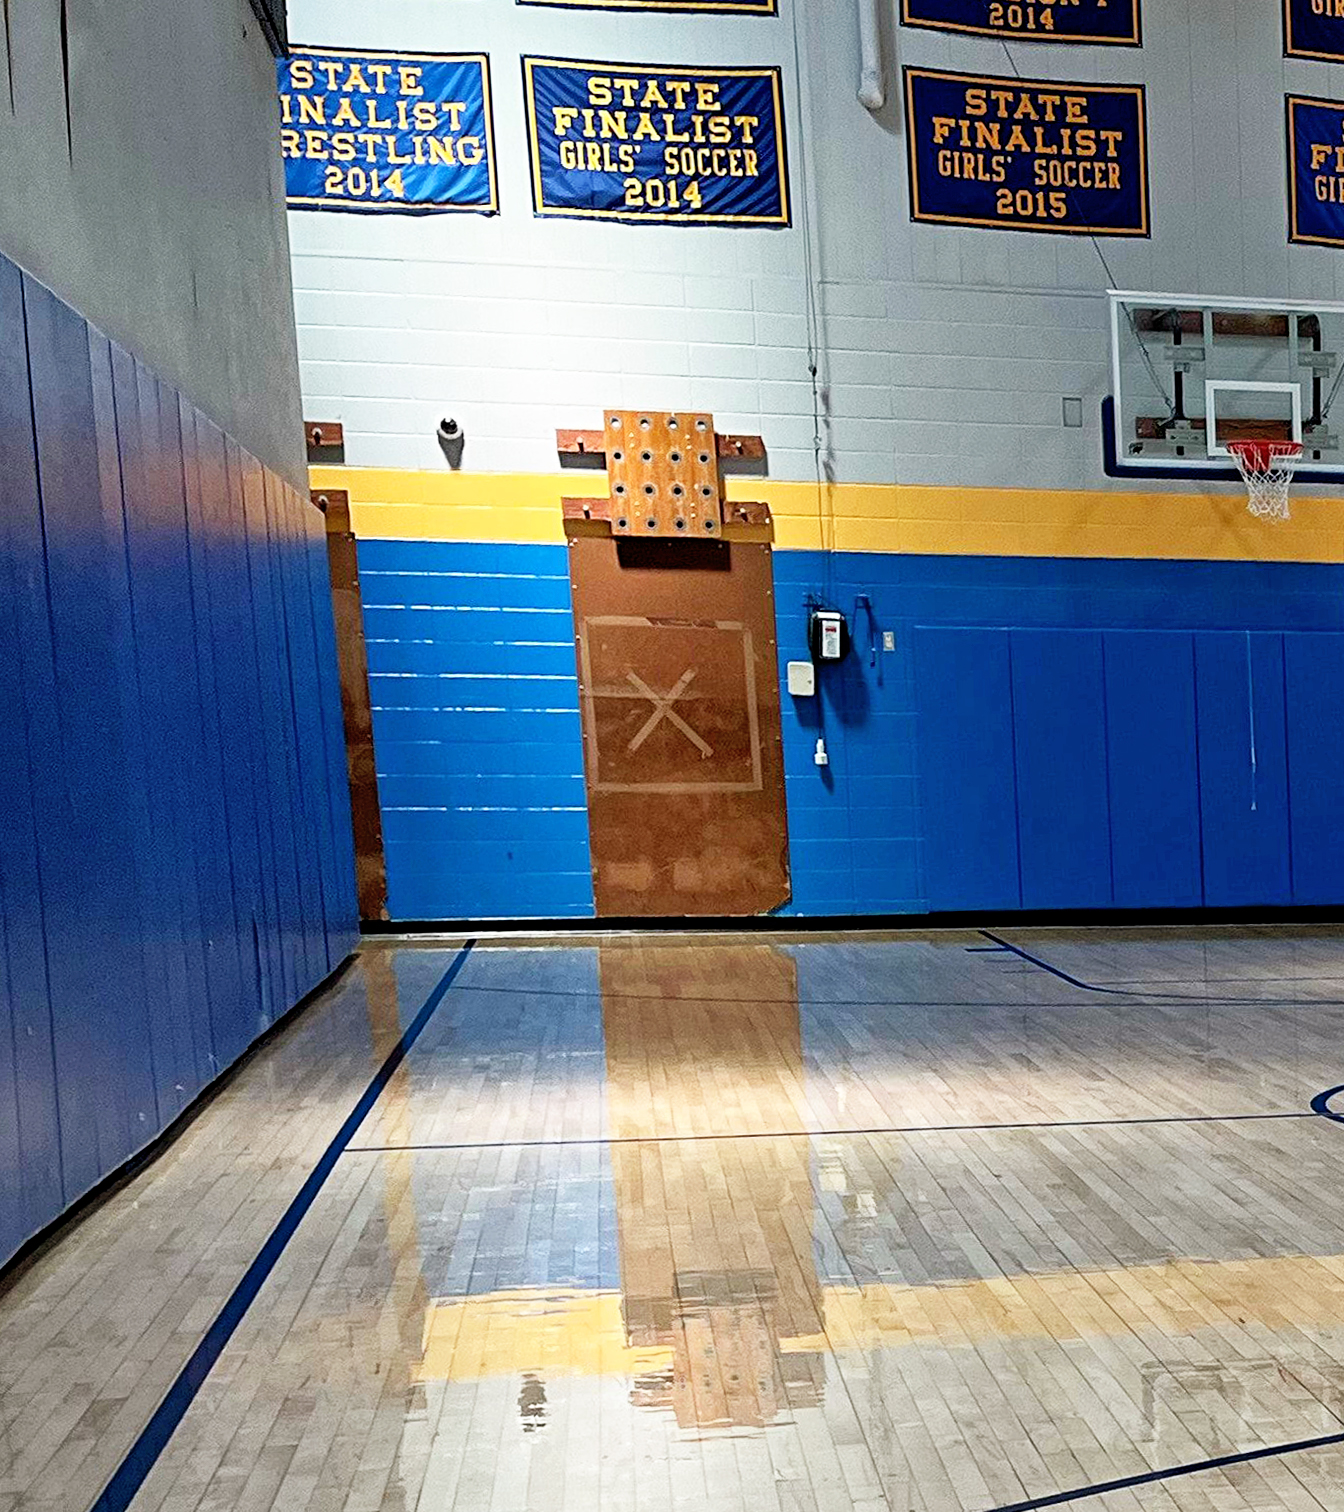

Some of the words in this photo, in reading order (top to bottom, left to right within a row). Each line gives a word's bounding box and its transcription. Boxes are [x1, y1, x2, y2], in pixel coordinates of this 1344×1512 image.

[989, 3, 1054, 30] 2014
[290, 60, 424, 95] STATE
[587, 77, 721, 111] STATE
[280, 95, 467, 131] INALIST
[965, 88, 1088, 123] STATE
[552, 107, 759, 144] FINALIST
[932, 116, 1122, 157] FINALIST
[281, 129, 484, 165] RESTLING
[560, 141, 641, 173] GIRLS'
[664, 146, 758, 177] SOCCER
[325, 165, 404, 197] 2014
[938, 150, 1011, 182] GIRLS'
[1034, 159, 1120, 189] SOCCER
[624, 177, 702, 209] 2014
[996, 188, 1067, 218] 2015
